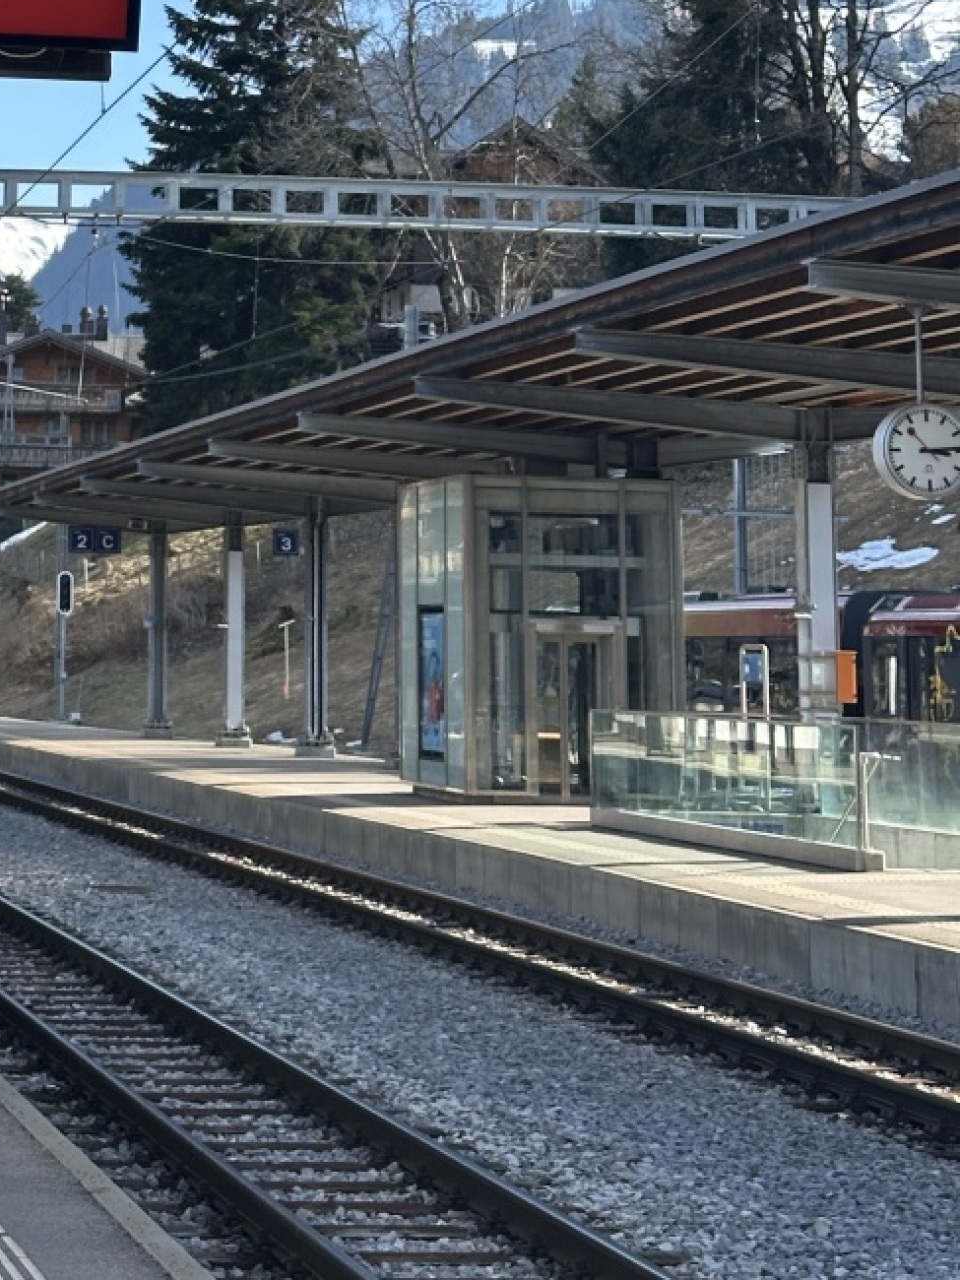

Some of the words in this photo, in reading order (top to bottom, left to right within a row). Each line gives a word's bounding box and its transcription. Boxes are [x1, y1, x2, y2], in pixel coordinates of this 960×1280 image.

[76, 533, 87, 549] 2
[101, 534, 114, 549] C
[280, 536, 292, 551] 3
